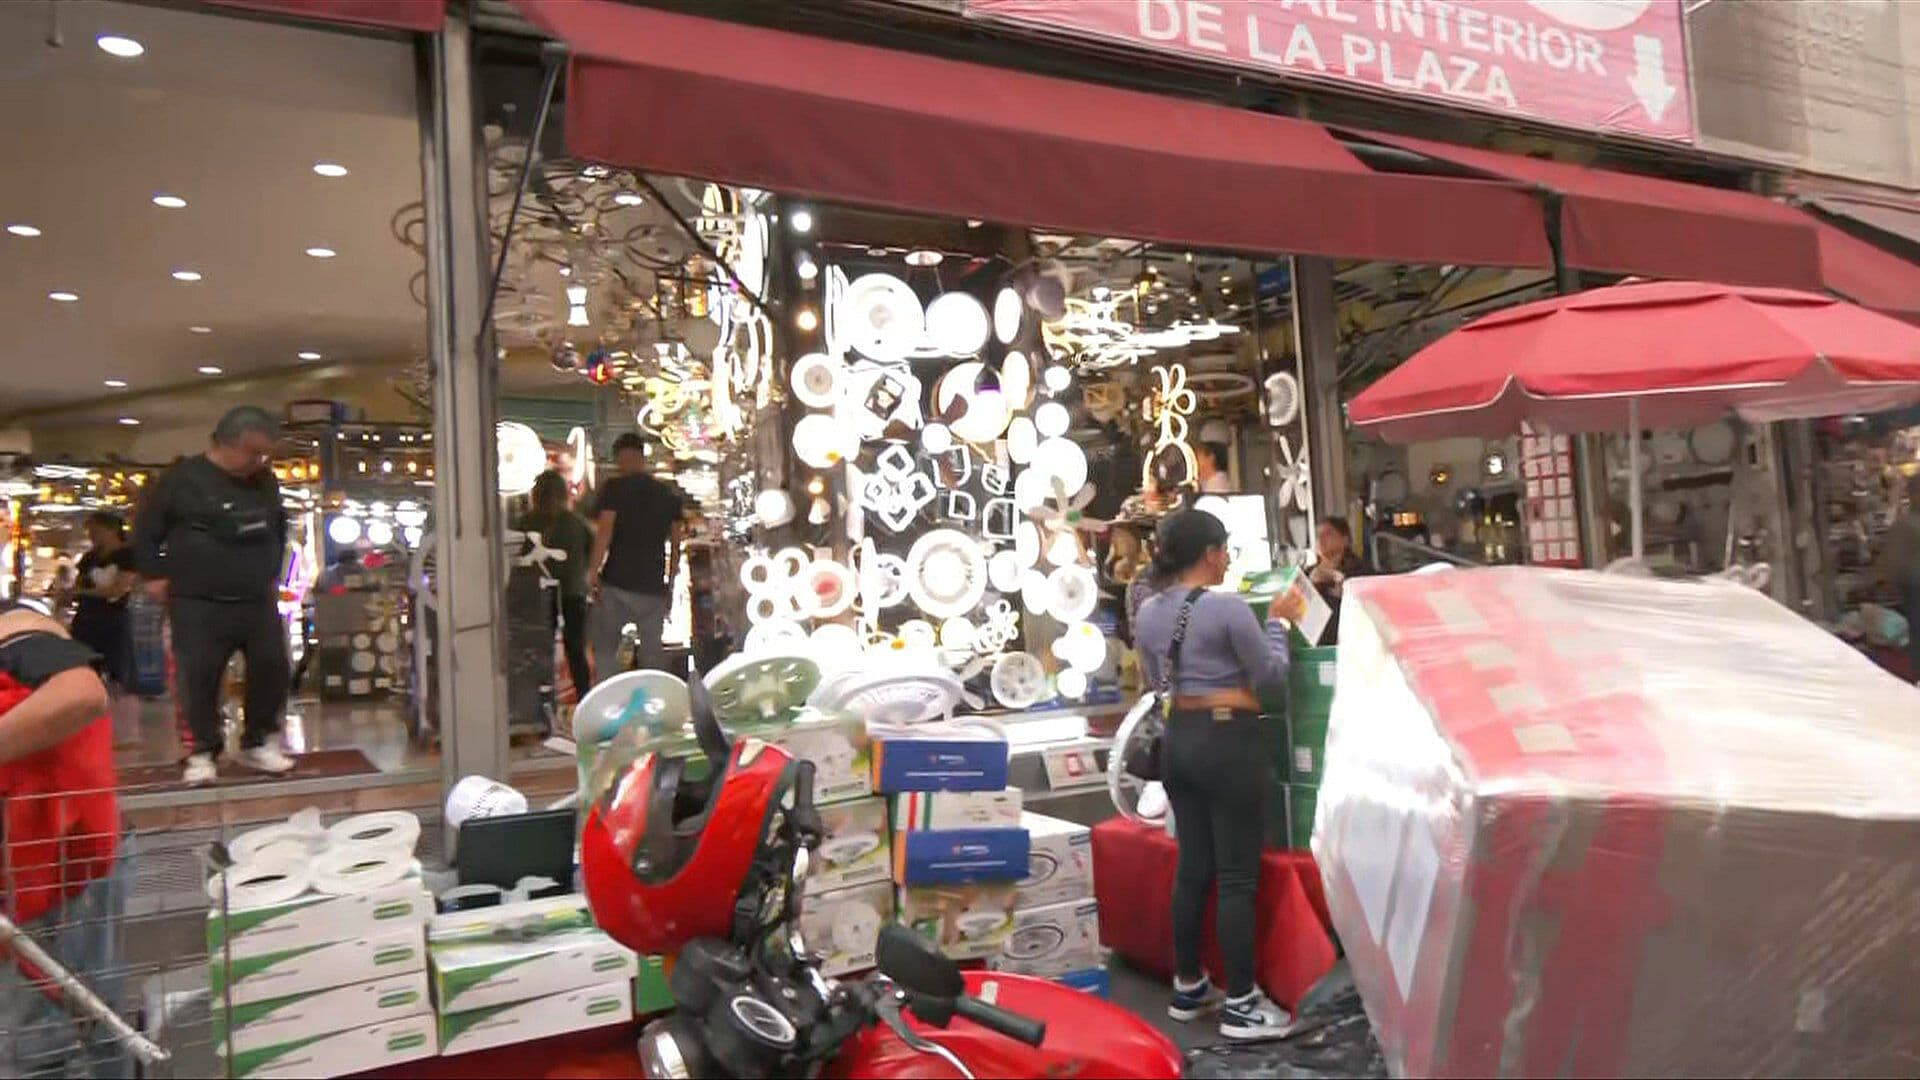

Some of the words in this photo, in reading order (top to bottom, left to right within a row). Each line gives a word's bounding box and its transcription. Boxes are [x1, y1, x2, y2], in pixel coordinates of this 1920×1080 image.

[1139, 0, 1227, 52] DE
[1248, 15, 1326, 71] LA
[1341, 34, 1517, 108] PLAZA
[1376, 0, 1607, 76] INTERIOR
